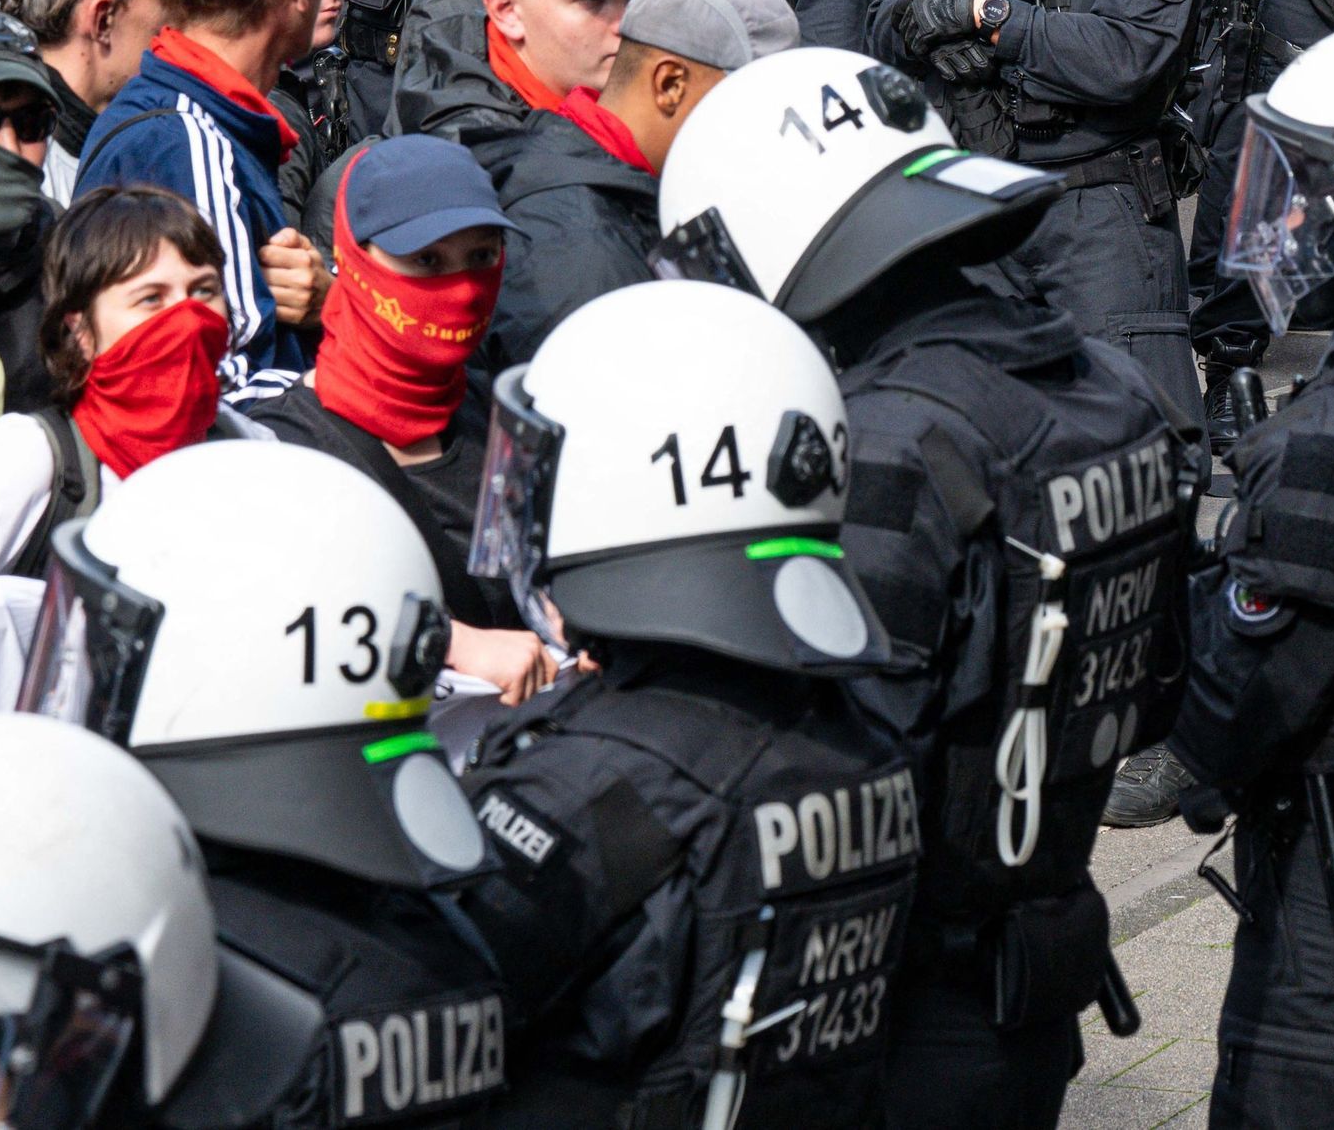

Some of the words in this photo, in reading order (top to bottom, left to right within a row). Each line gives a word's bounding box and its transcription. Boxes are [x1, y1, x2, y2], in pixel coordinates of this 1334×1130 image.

[778, 83, 866, 155] 14
[651, 424, 752, 506] 14
[1085, 560, 1160, 637] NRW
[284, 604, 382, 685] 13
[477, 792, 557, 863] POLIZEI
[798, 902, 899, 987] NRW
[777, 975, 887, 1062] 31433
